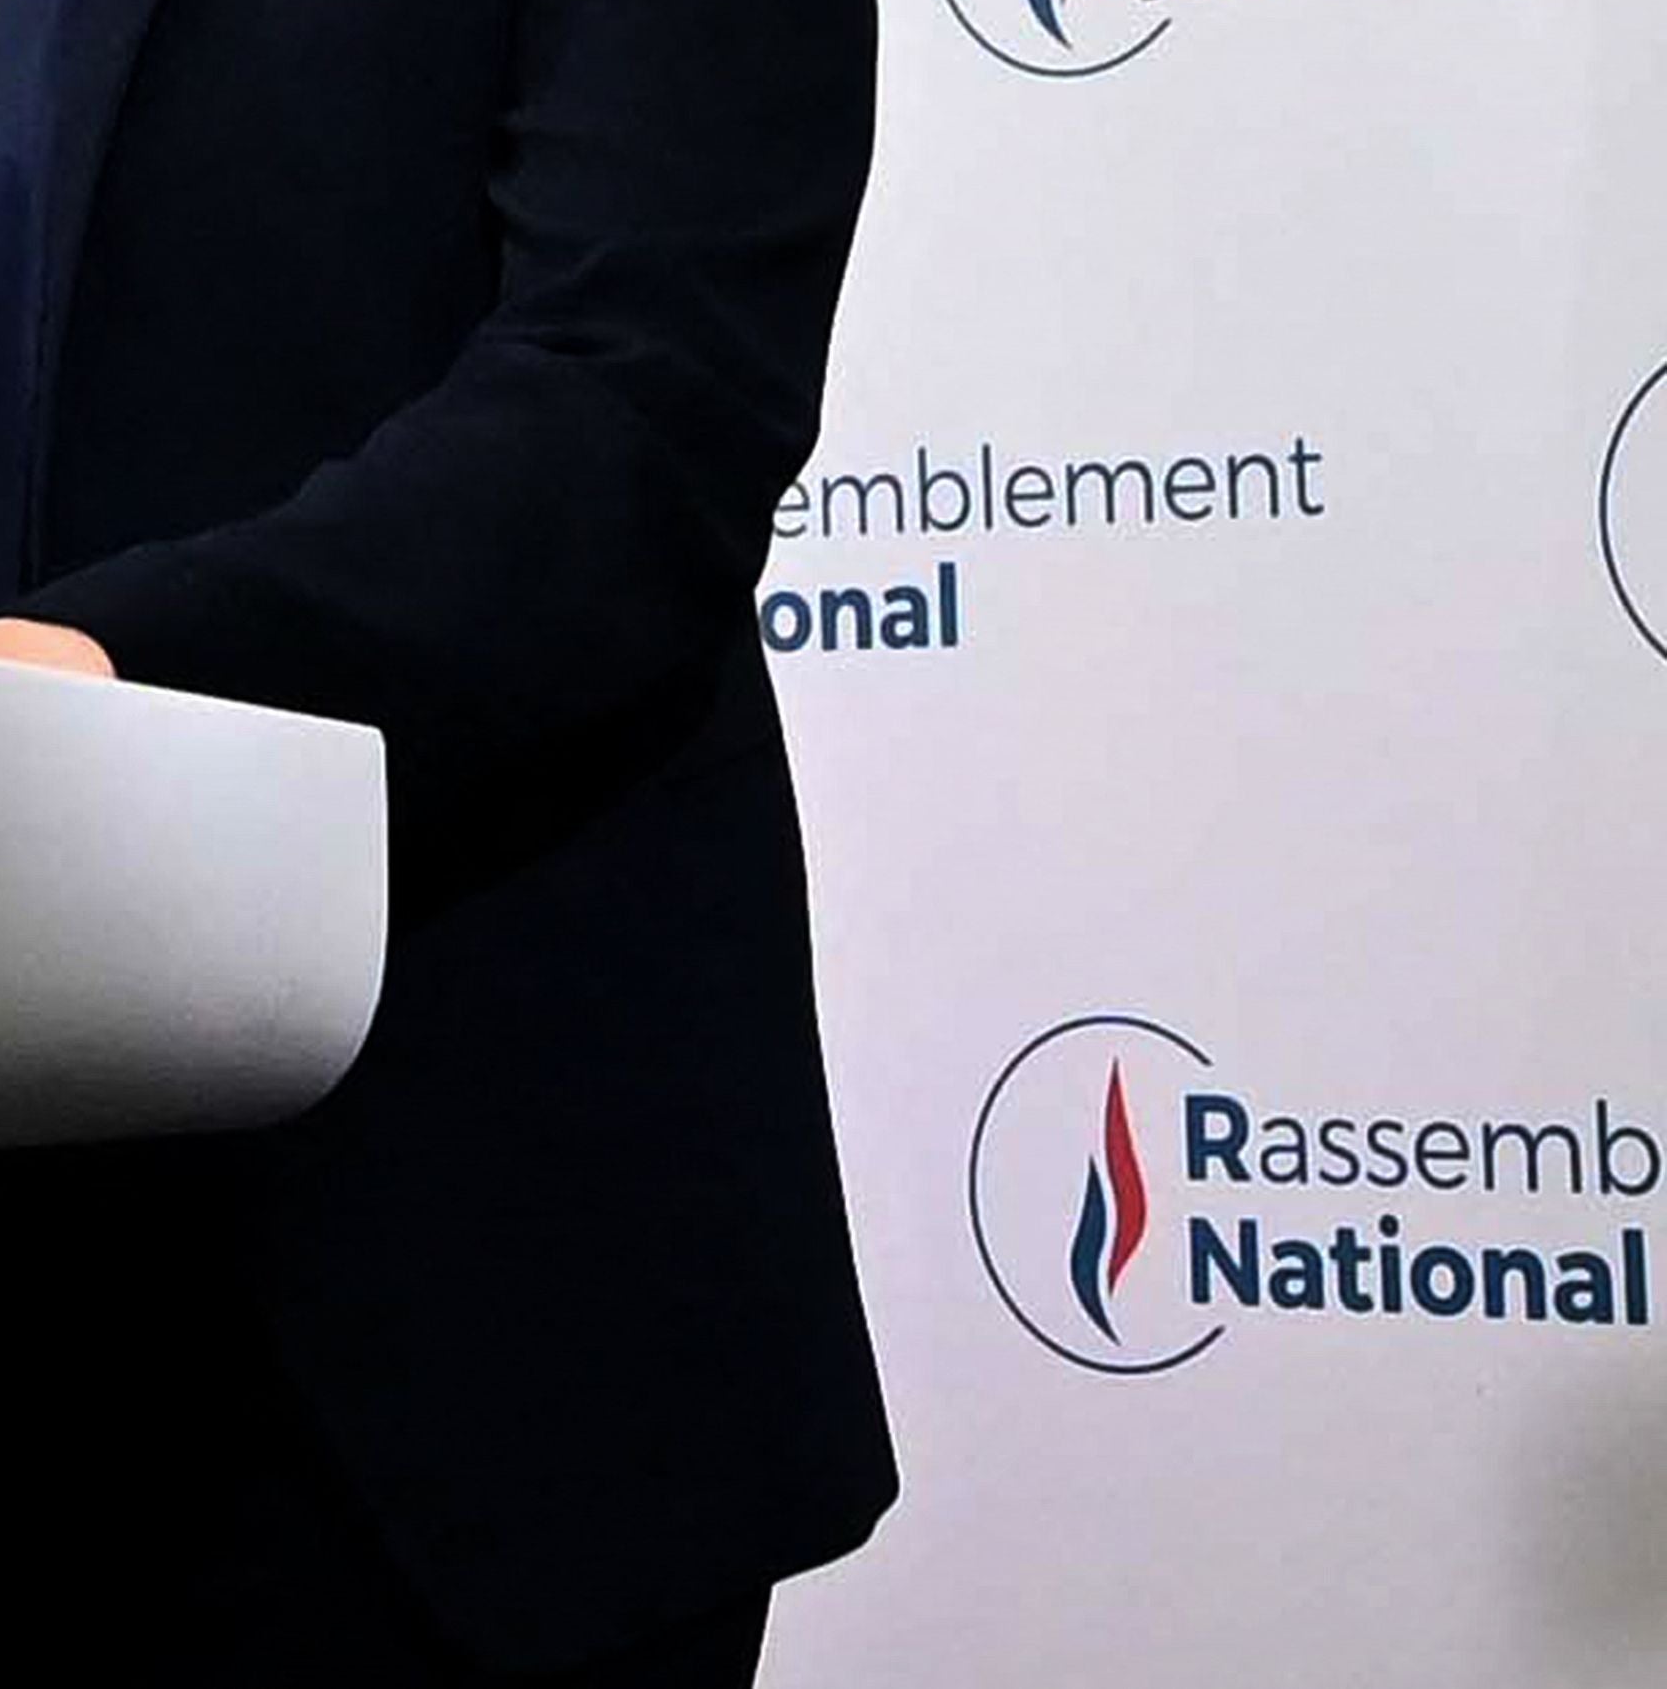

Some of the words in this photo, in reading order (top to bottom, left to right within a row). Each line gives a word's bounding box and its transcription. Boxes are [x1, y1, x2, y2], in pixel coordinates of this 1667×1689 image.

[760, 561, 959, 653] onal
[1184, 1093, 1663, 1197] Rassemb
[1188, 1213, 1650, 1327] National
